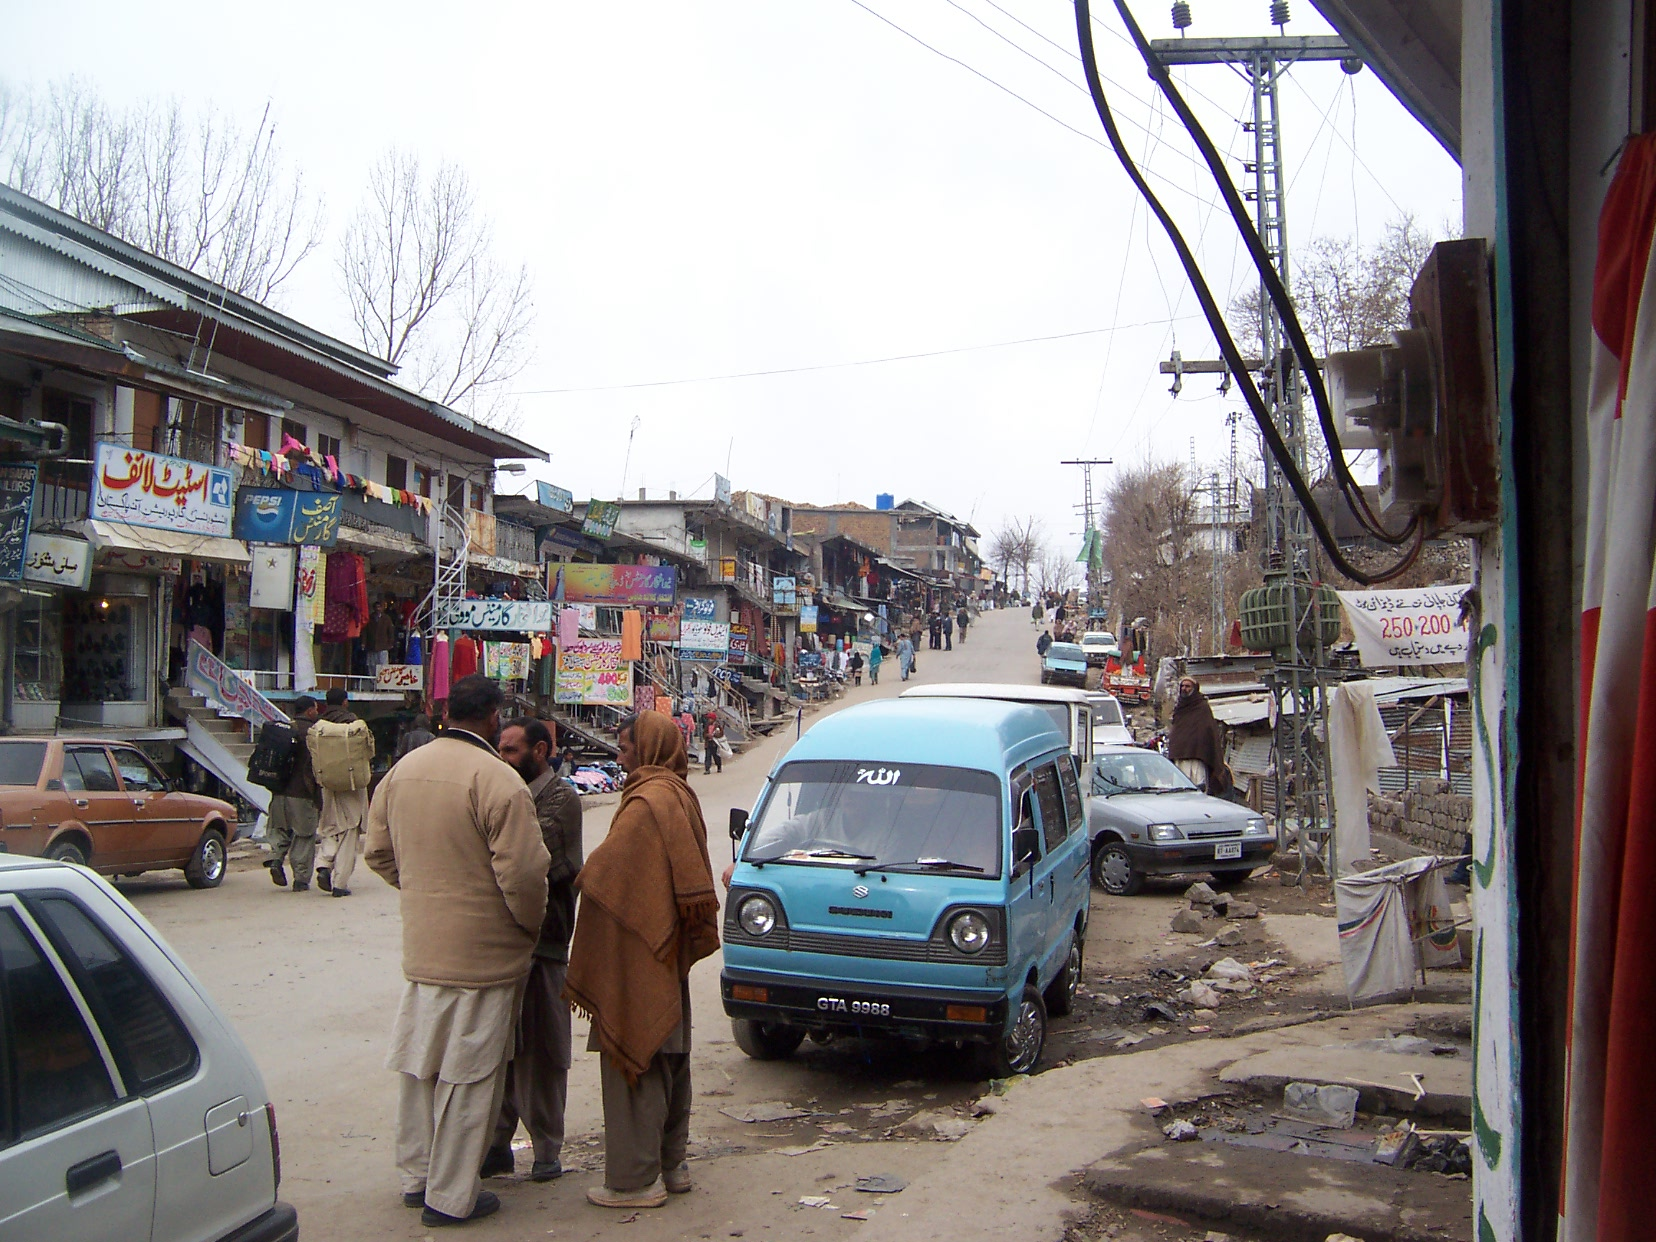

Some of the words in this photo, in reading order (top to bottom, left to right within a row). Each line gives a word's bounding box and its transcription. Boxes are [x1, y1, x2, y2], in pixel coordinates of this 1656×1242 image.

[102, 451, 155, 493] لائف
[244, 494, 283, 507] PEPSI
[301, 494, 340, 516] آصف
[1380, 616, 1413, 639] 250
[1418, 614, 1451, 636] 200
[856, 767, 901, 785] اللہ
[817, 997, 848, 1013] GTA
[851, 1001, 890, 1016] 9988
